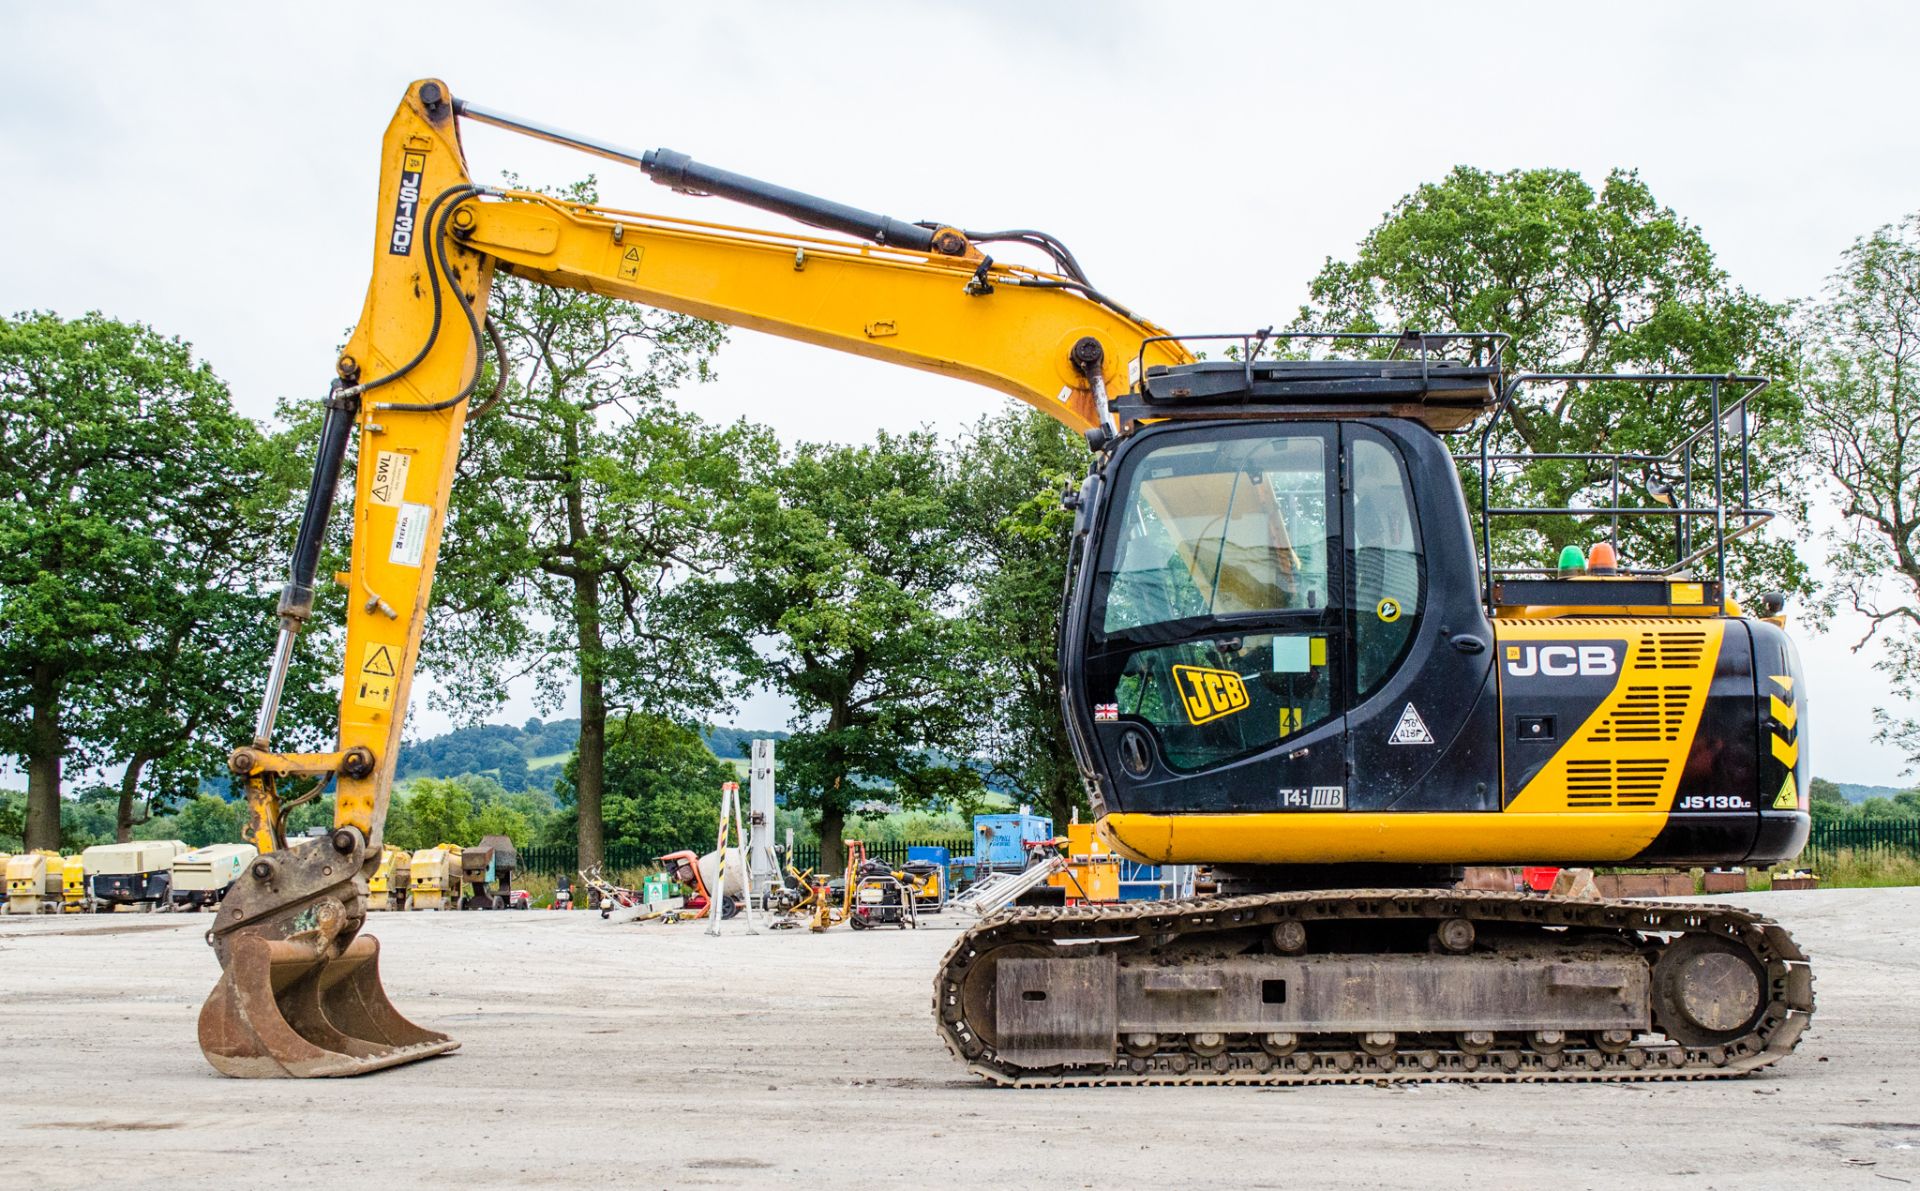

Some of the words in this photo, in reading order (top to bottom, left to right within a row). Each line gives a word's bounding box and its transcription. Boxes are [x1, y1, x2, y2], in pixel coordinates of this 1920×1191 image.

[393, 173, 419, 246] JS130
[377, 454, 392, 483] SWL
[1506, 646, 1617, 676] JCB
[1186, 671, 1244, 718] JCB
[1280, 789, 1309, 806] T4i
[1311, 789, 1341, 806] IIIB
